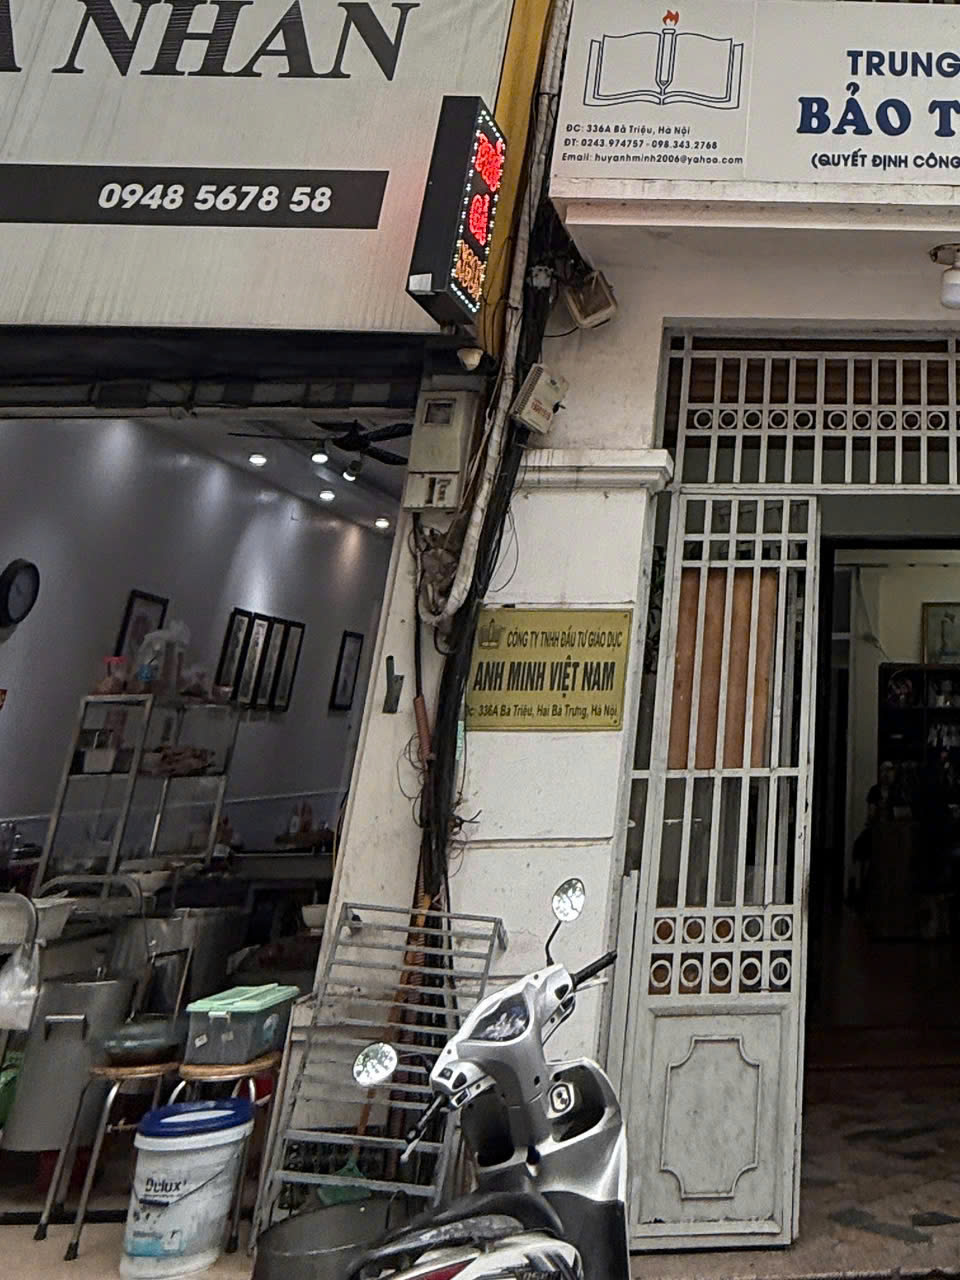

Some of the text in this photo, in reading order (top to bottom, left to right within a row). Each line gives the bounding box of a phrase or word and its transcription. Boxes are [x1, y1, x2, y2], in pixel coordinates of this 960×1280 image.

[797, 81, 911, 136] BẢO
[586, 124, 611, 134] 336A
[613, 124, 626, 134] Bà
[629, 124, 655, 136] Triệu,
[674, 125, 690, 137] Nội
[562, 152, 592, 162] Email:
[811, 148, 867, 169] (QUYẾT
[872, 155, 908, 171] ĐỊNH
[98, 183, 332, 213] 0948 5678 58
[507, 626, 528, 648] CÔNG
[530, 631, 540, 648] TY
[540, 631, 560, 648] TNHH
[473, 654, 616, 698] ANH MINH VIỆT NAM
[479, 704, 498, 717] 336A
